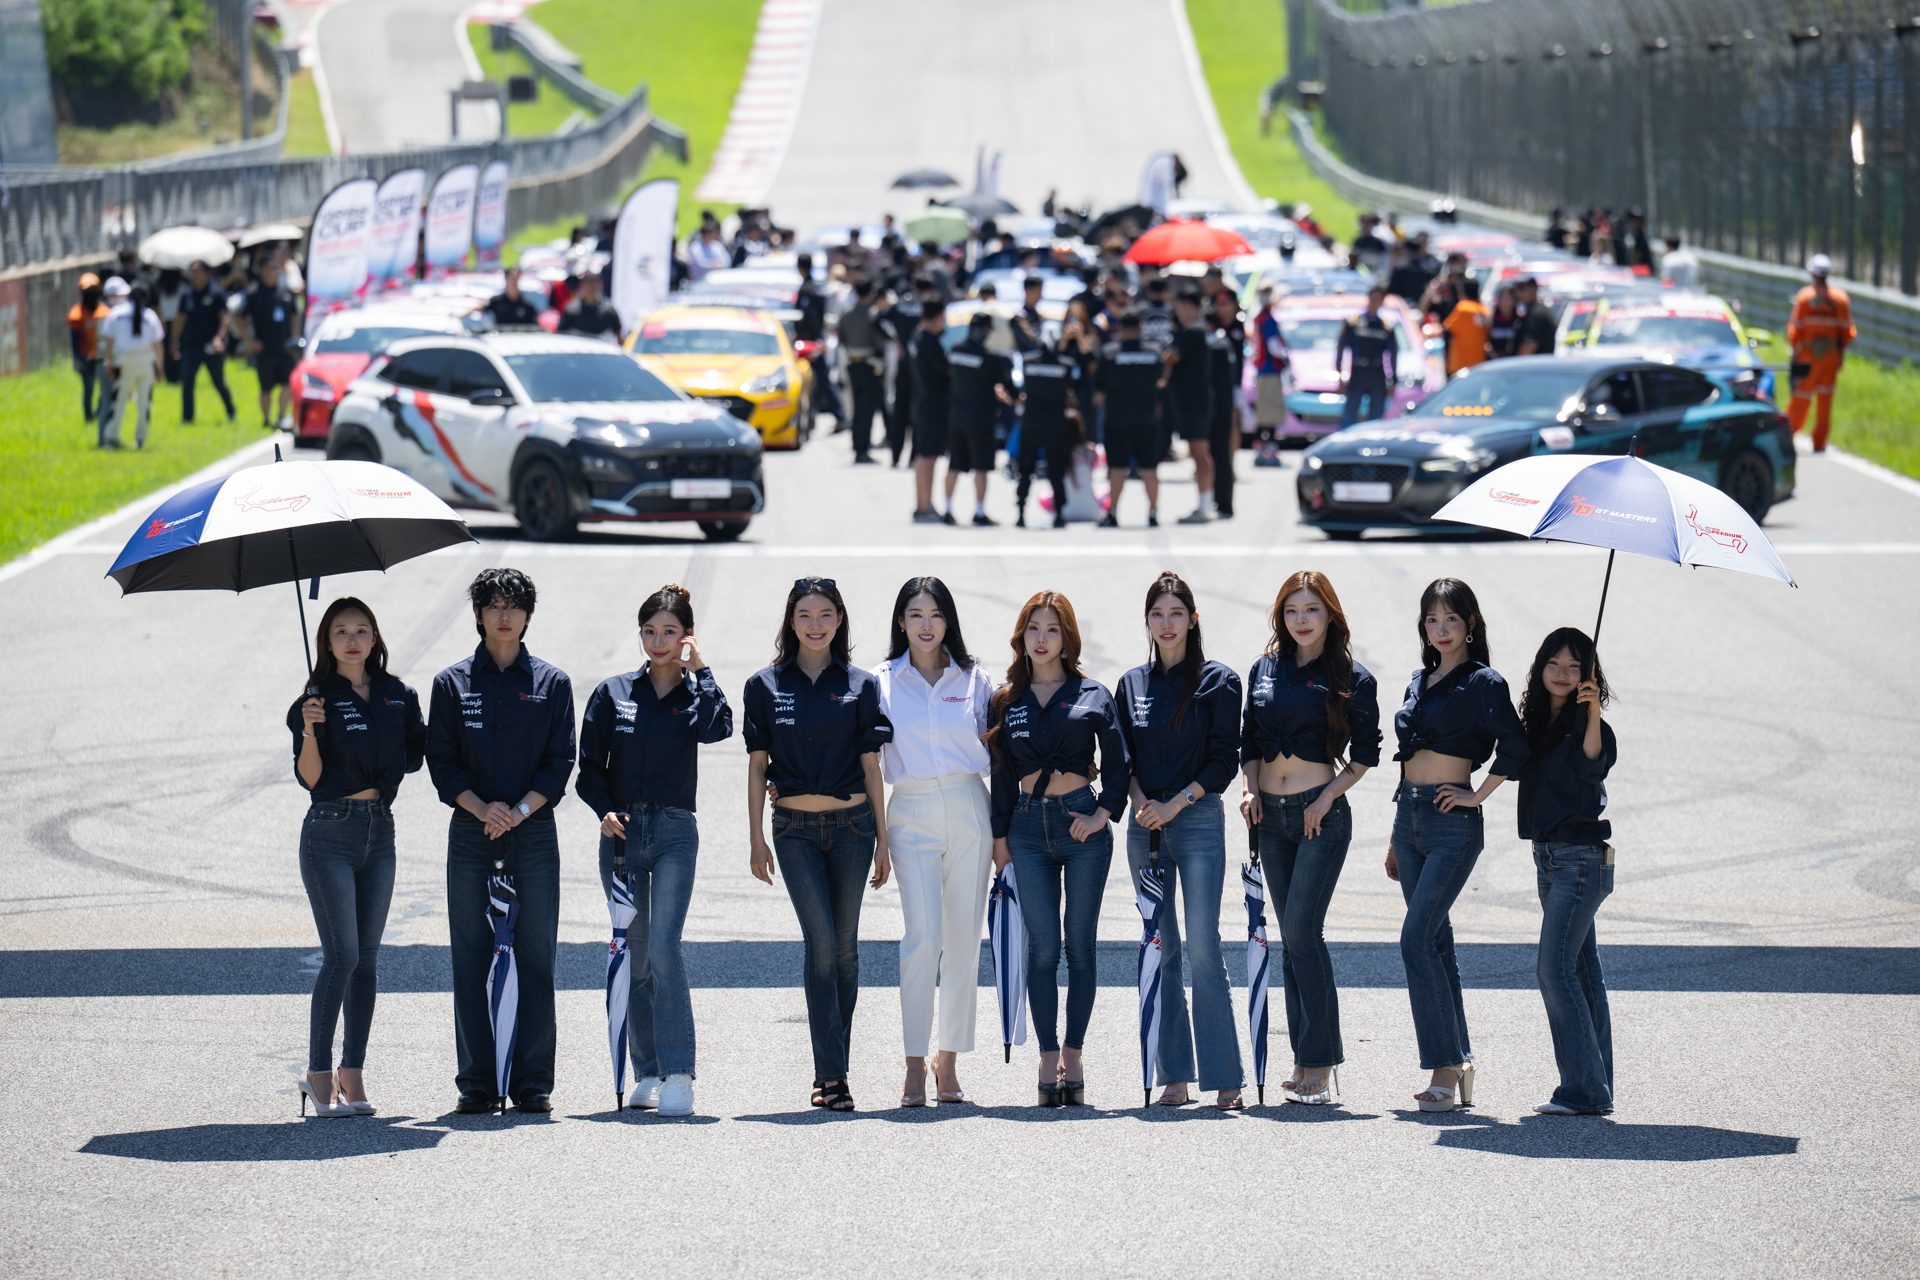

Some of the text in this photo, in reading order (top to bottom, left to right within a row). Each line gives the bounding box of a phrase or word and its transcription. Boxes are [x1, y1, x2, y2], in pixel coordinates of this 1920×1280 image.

[1609, 511, 1658, 523] MASTERS
[1703, 526, 1742, 538] SPEEDIUM
[1009, 718, 1028, 727] MIK
